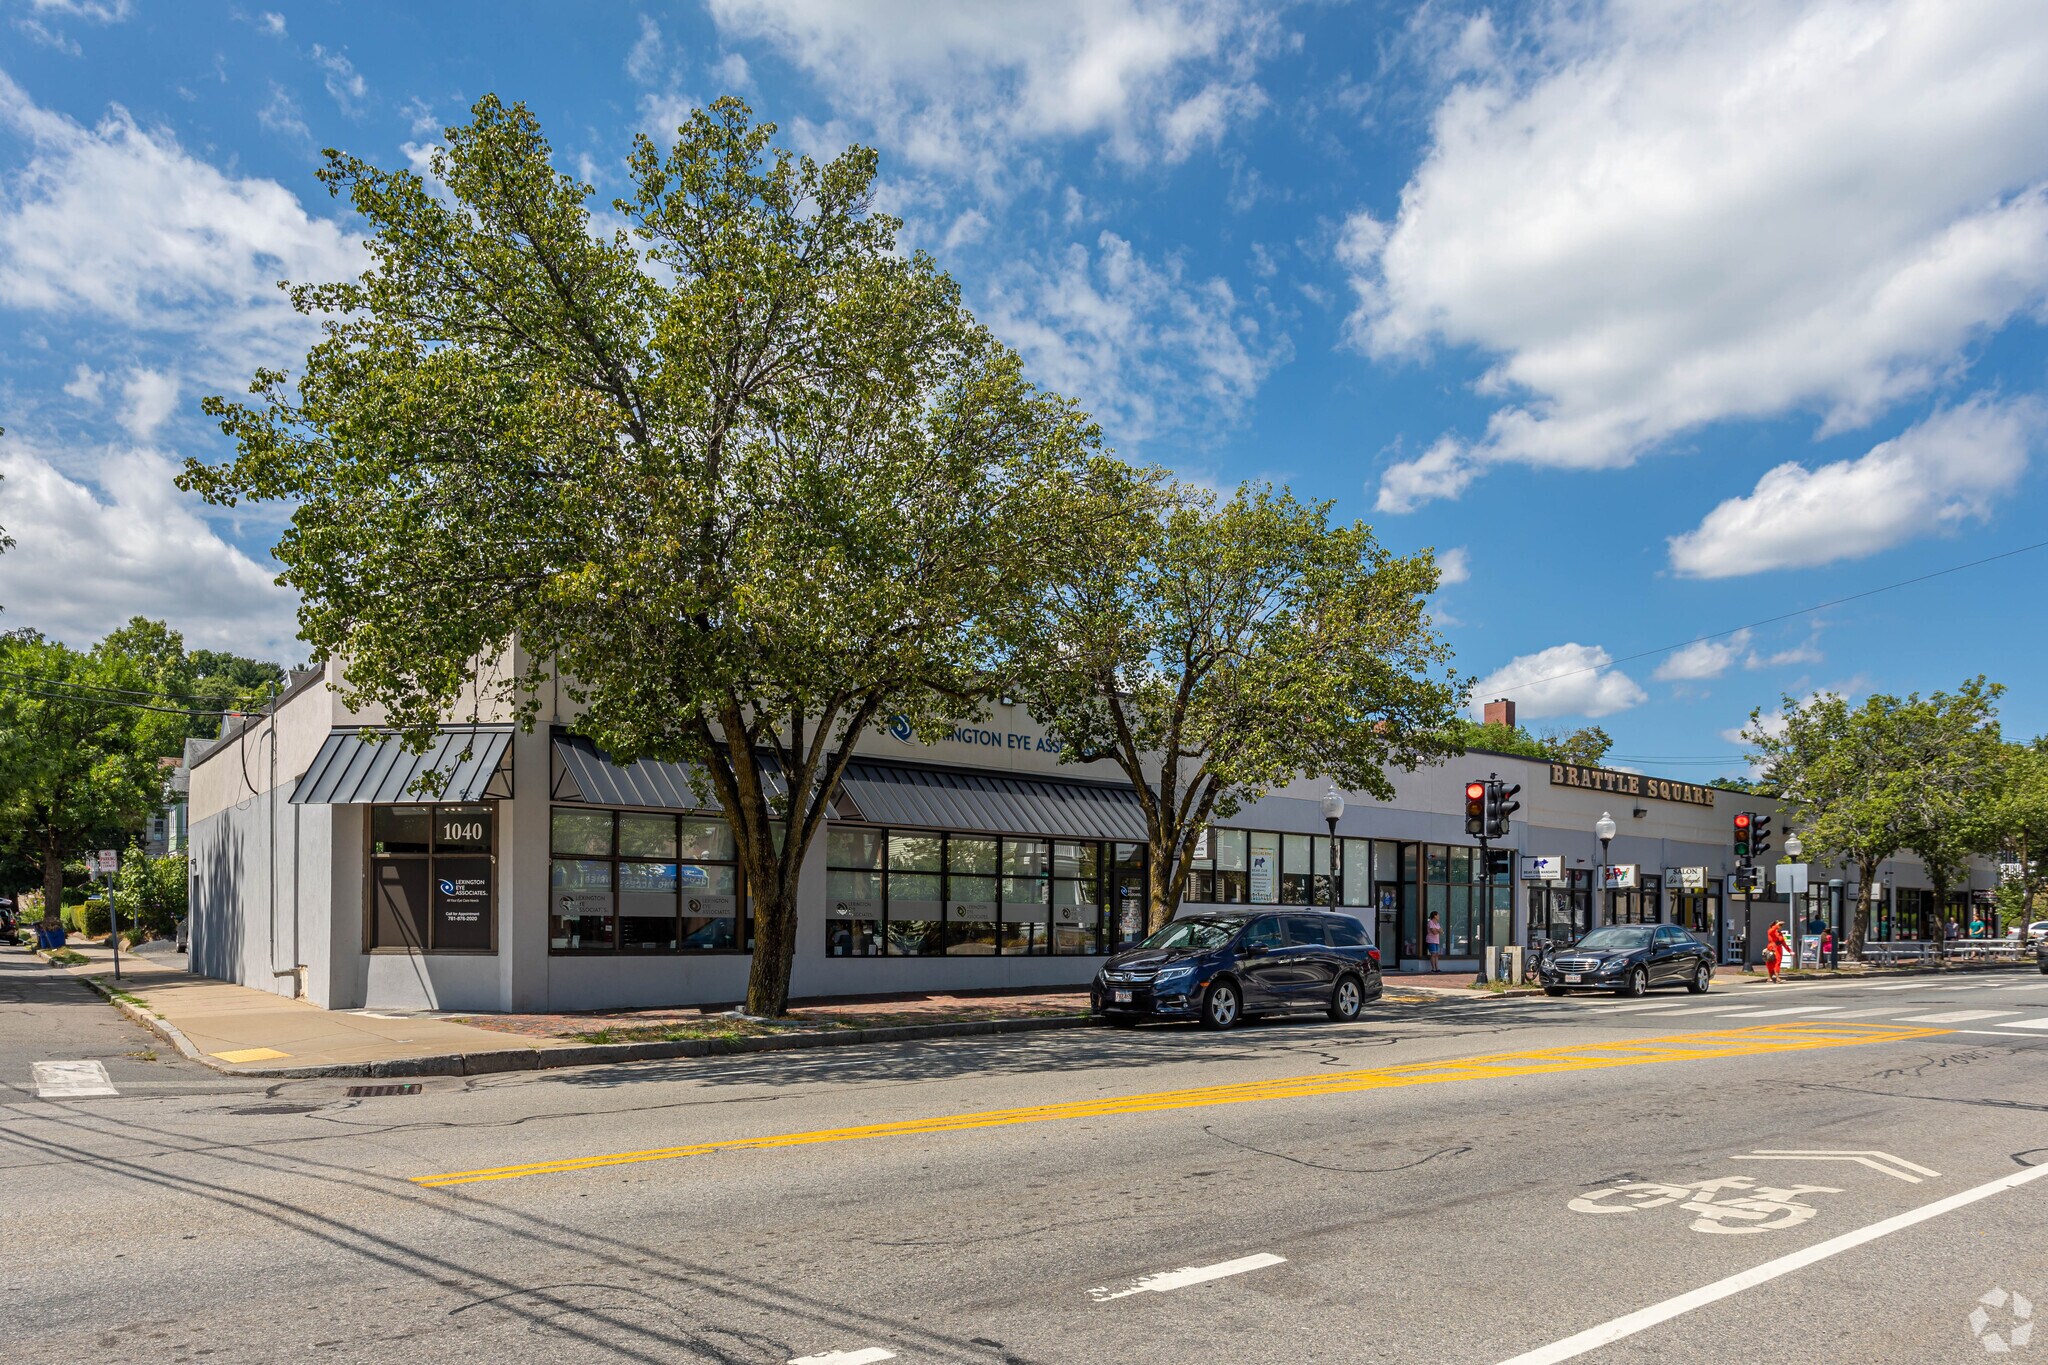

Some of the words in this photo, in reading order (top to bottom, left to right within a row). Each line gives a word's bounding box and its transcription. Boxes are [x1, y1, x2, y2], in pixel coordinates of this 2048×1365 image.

[1007, 733, 1032, 751] EYE
[1552, 763, 1639, 795] BRATTLE
[1647, 779, 1715, 806] SQUARE
[443, 823, 483, 840] 1040
